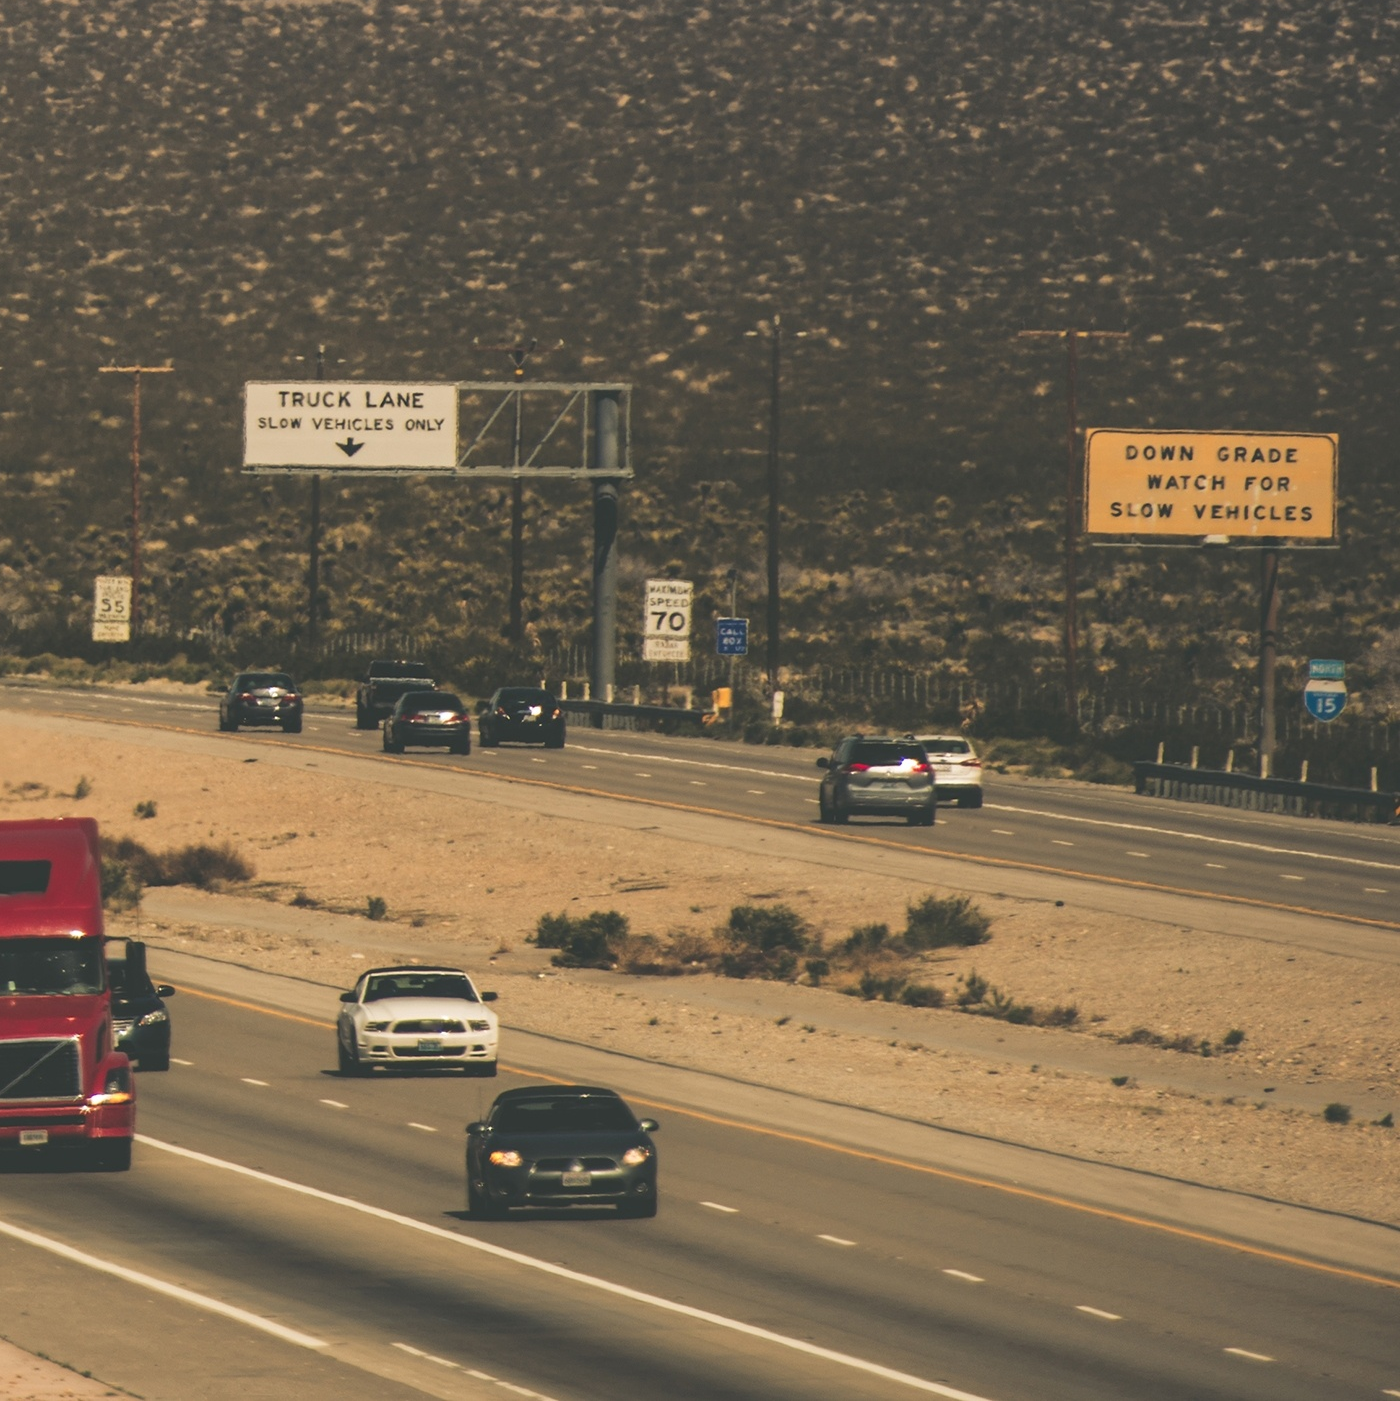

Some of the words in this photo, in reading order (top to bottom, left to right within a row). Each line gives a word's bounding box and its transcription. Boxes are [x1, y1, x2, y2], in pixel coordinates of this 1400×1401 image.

[278, 390, 351, 408] TRUCK
[365, 391, 424, 409] LANE
[257, 417, 303, 430] SLOW
[312, 417, 394, 431] VEHICLES
[405, 418, 445, 431] ONLY
[1125, 444, 1194, 462] DOWN
[1217, 446, 1298, 464] GRADE
[1147, 474, 1226, 491] WATCH
[1244, 476, 1291, 492] FOR
[1110, 501, 1174, 518] SLOW
[1193, 504, 1313, 522] VEHICLES
[649, 585, 690, 595] MAXIMUM
[649, 597, 690, 608] SPEED
[650, 610, 686, 632] 70
[720, 627, 744, 636] CALL
[722, 637, 742, 645] BOX
[1316, 697, 1337, 714] 15
